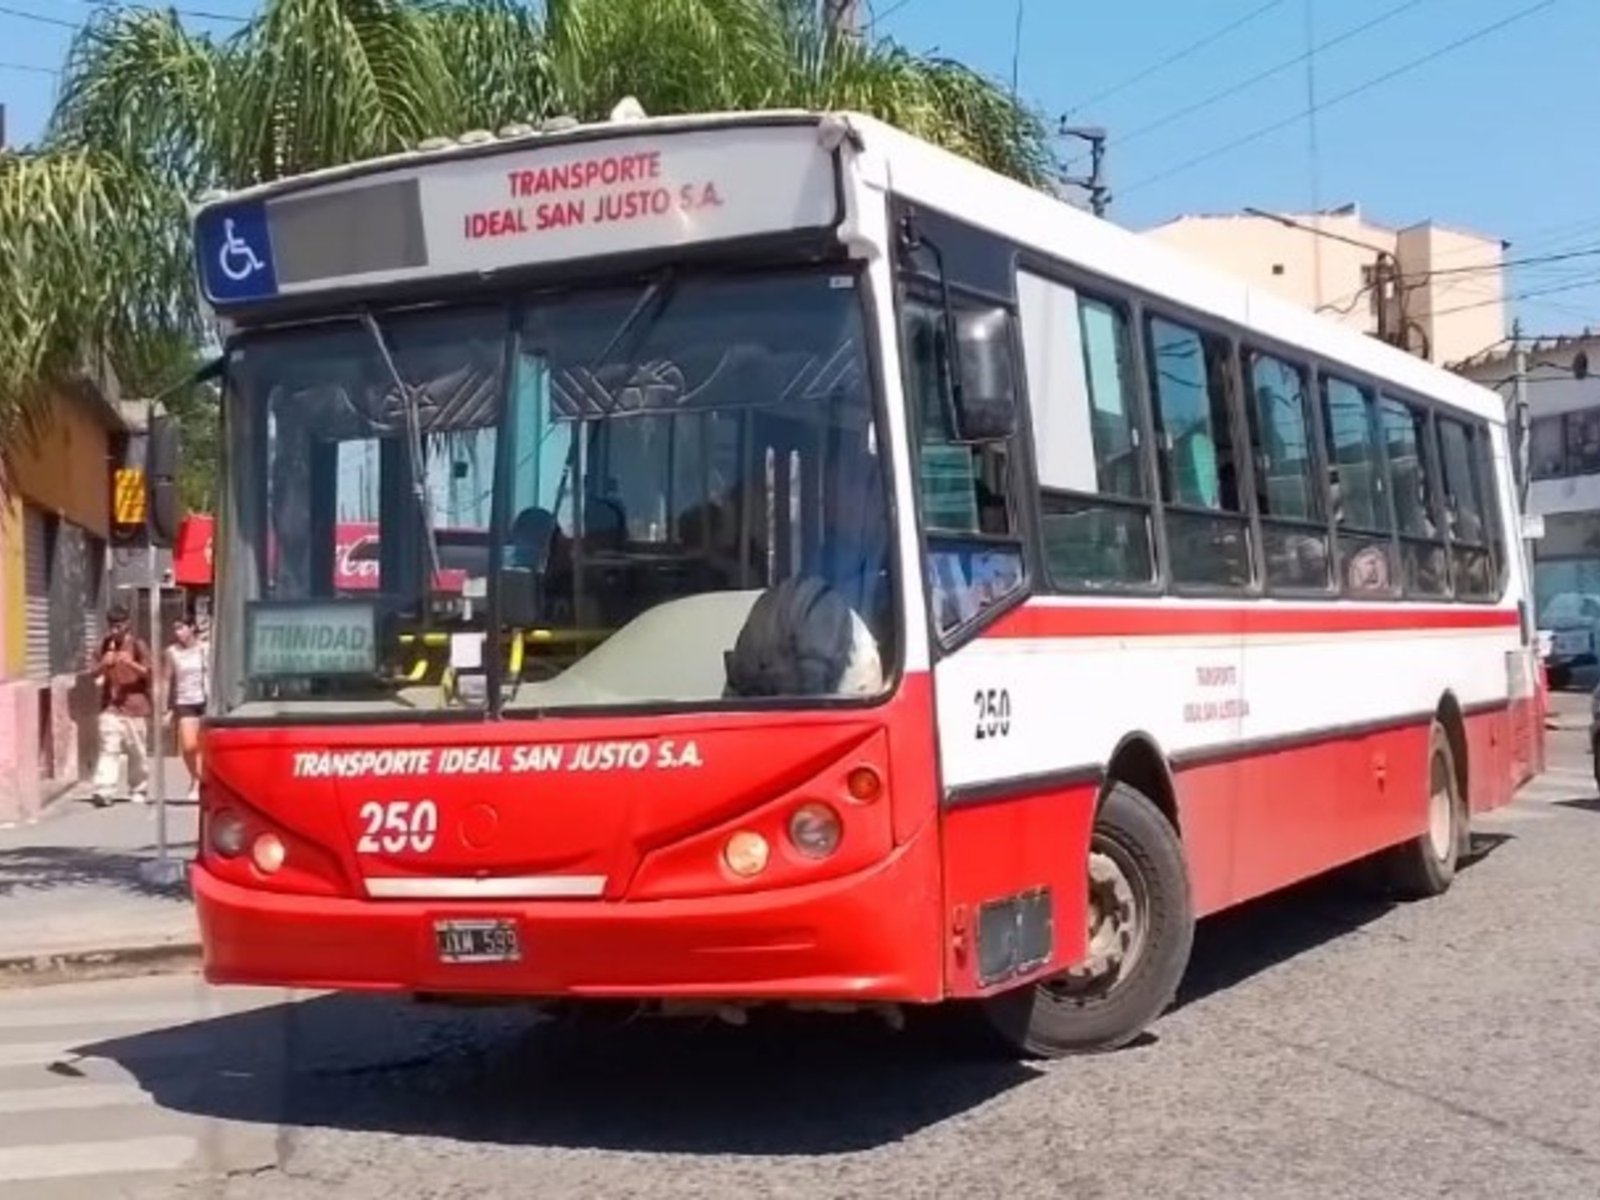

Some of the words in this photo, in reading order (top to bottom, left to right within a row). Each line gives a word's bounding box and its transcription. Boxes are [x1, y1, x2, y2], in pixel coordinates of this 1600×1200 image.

[508, 152, 661, 197] TRANSPORTE
[464, 208, 527, 238] IDEAL
[535, 198, 585, 231] SAN
[594, 188, 670, 222] JUSTO
[680, 182, 723, 208] S.A.
[258, 624, 367, 650] TRINIDAD
[974, 687, 1011, 740] 250
[293, 750, 431, 776] TRANSPORTE
[439, 747, 502, 774] IDEAL
[511, 746, 562, 771] SAN
[568, 743, 649, 770] JUSTO
[657, 741, 702, 767] S.A.
[357, 800, 437, 853] 250
